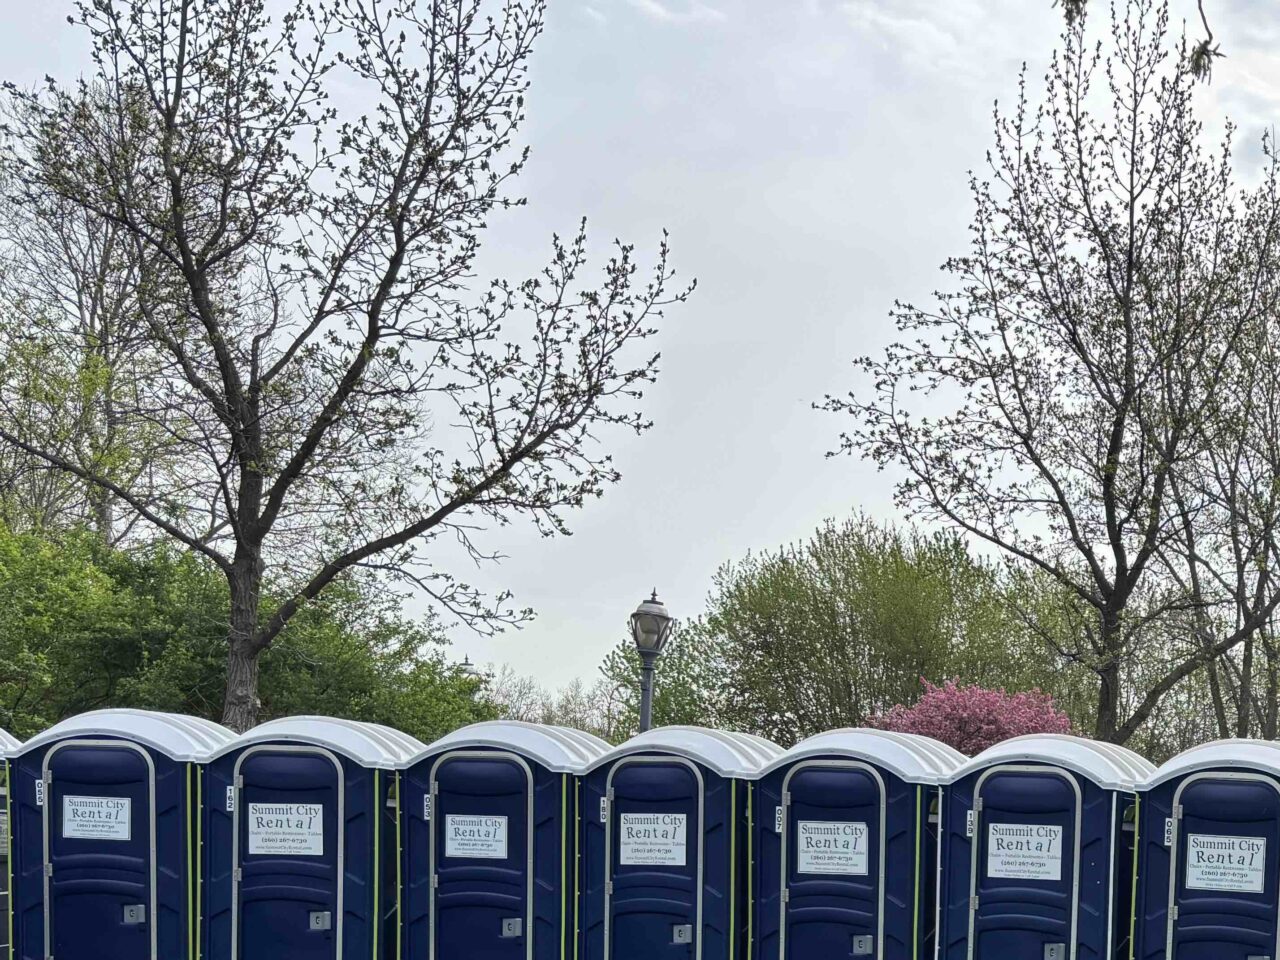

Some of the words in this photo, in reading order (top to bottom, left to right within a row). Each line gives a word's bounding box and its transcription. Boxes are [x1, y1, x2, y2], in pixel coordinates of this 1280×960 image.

[68, 799, 103, 809] Summit
[106, 800, 126, 811] City
[251, 805, 293, 815] Summit
[296, 805, 320, 817] City
[72, 808, 120, 820] Rental
[256, 817, 312, 829] Rental
[450, 818, 482, 827] Summit
[485, 819, 502, 829] City
[623, 814, 659, 825] Summit
[662, 815, 684, 828] City
[454, 827, 497, 838] Rental
[626, 827, 677, 839] Rental
[801, 824, 840, 835] Summit
[843, 825, 864, 838] City
[992, 825, 1033, 837] Summit
[1036, 826, 1059, 840] City
[805, 836, 858, 850] Rental
[996, 838, 1052, 852] Rental
[1191, 838, 1235, 850] Summit
[1238, 840, 1262, 854] City
[1196, 851, 1254, 866] Rental
